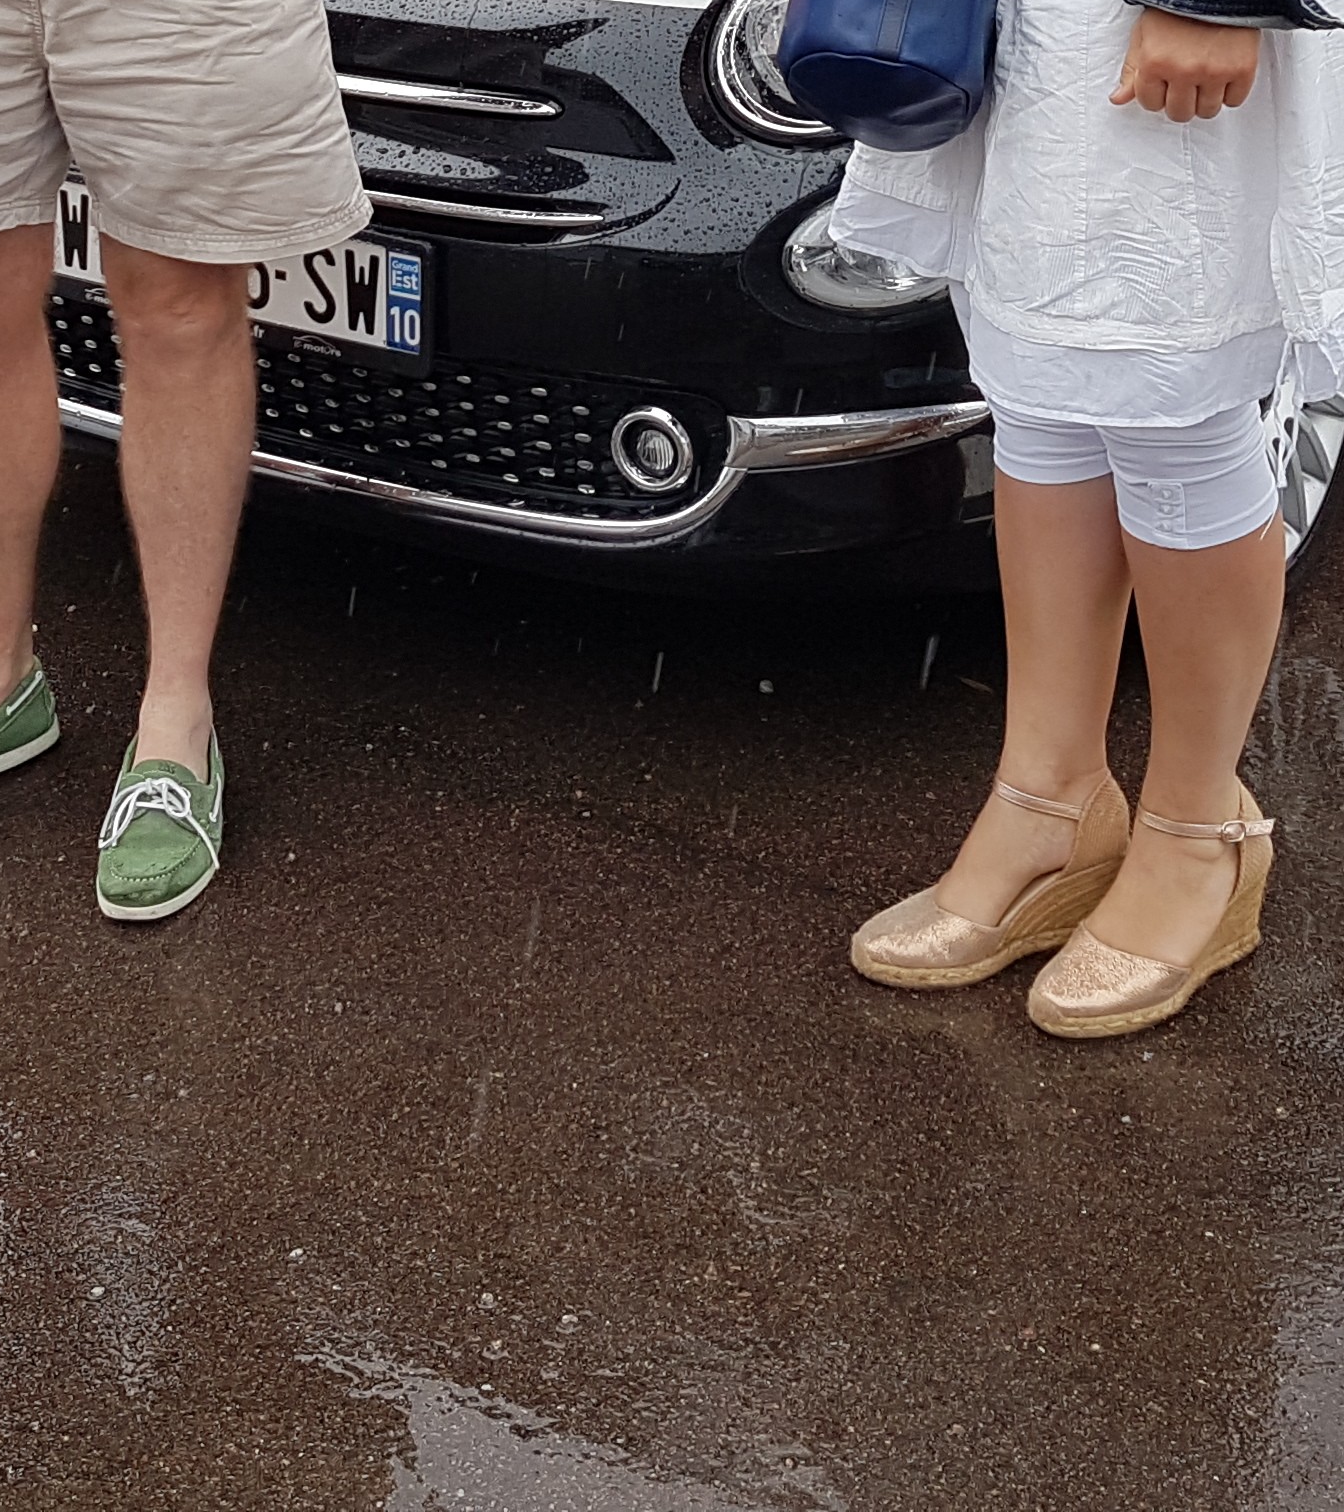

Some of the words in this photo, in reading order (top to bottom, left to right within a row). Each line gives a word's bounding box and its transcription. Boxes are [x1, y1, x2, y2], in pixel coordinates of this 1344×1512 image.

[391, 260, 419, 273] Grand
[391, 271, 419, 291] Est
[390, 306, 421, 346] 10
